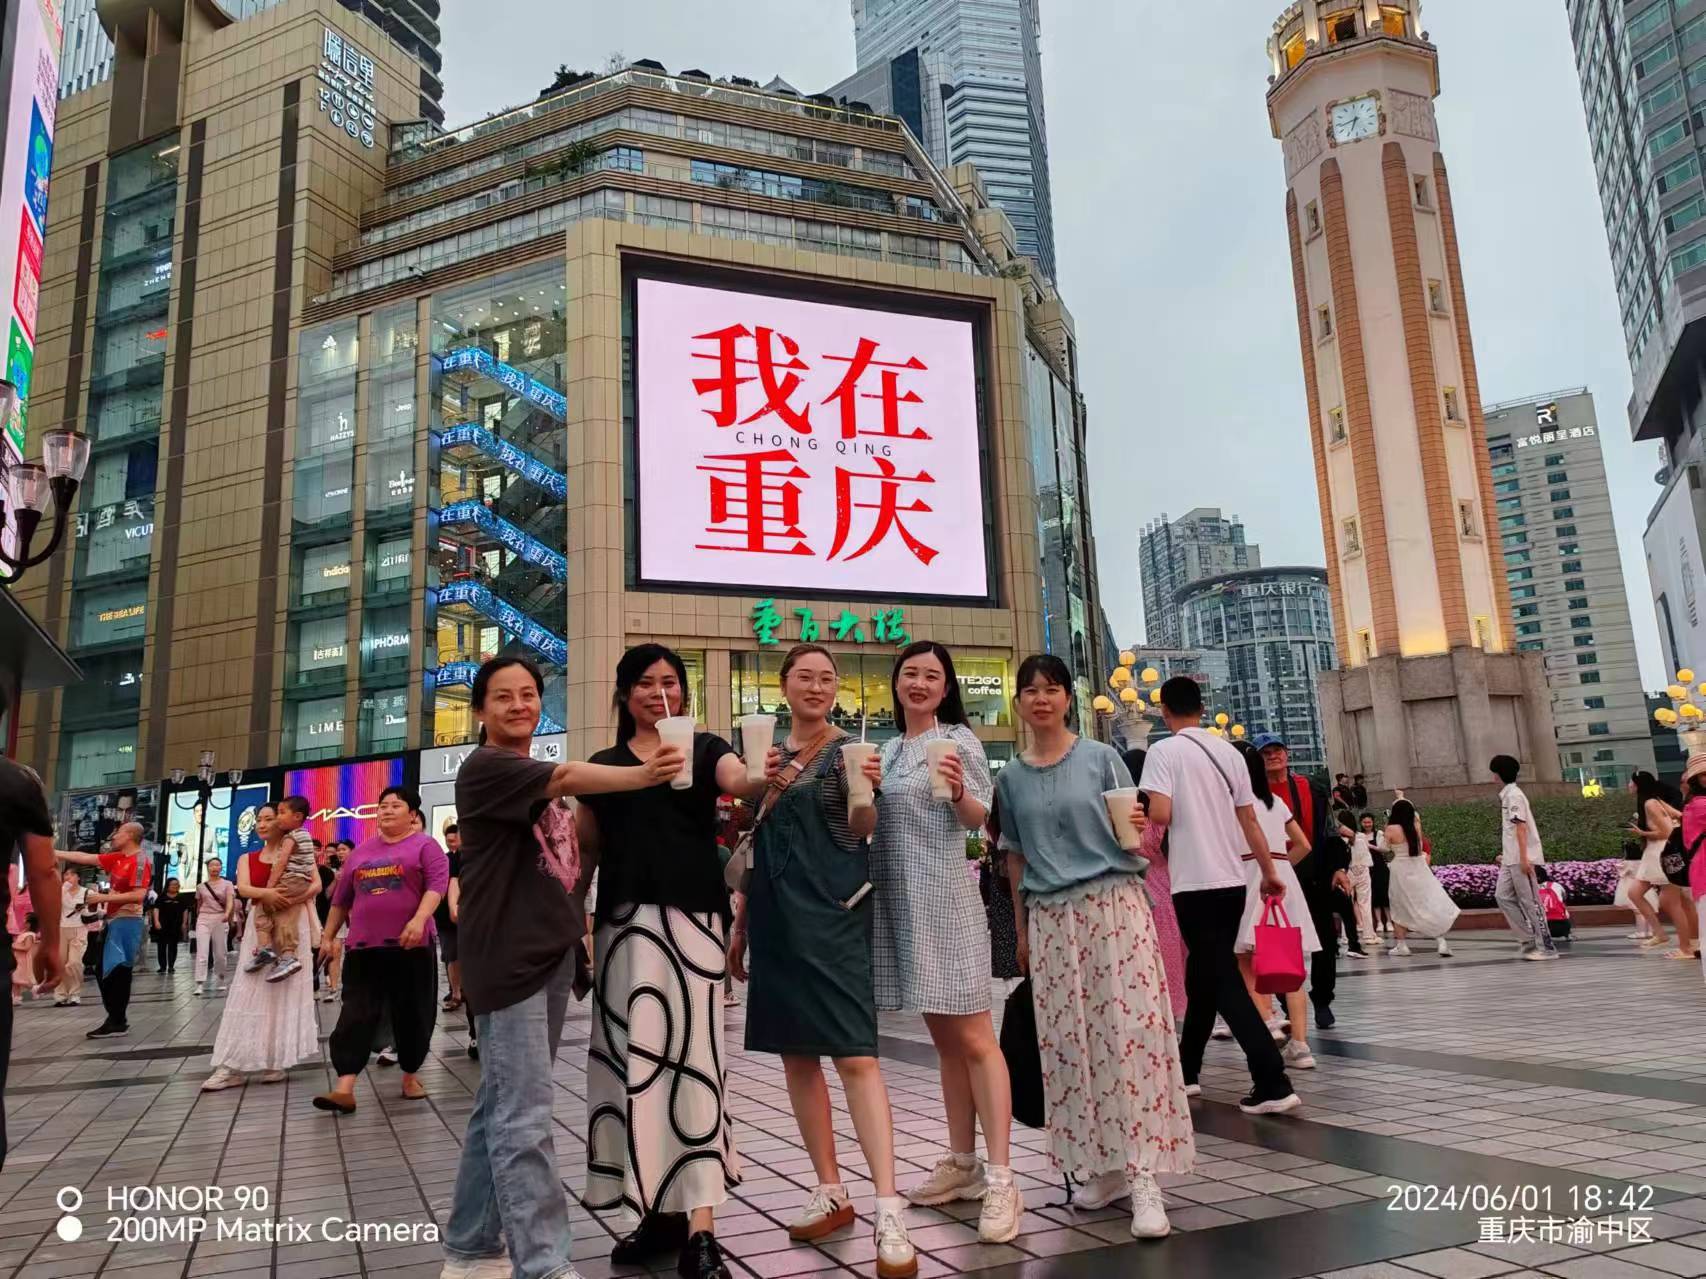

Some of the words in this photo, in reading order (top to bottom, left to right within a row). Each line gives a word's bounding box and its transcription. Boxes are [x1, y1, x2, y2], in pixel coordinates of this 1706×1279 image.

[691, 323, 933, 440] 我在
[735, 431, 818, 450] CHONG
[836, 440, 892, 457] QING
[695, 449, 939, 566] 重庆
[1240, 581, 1312, 597] 重庆银行
[750, 598, 911, 648] 重百大楼
[310, 721, 344, 735] LIME
